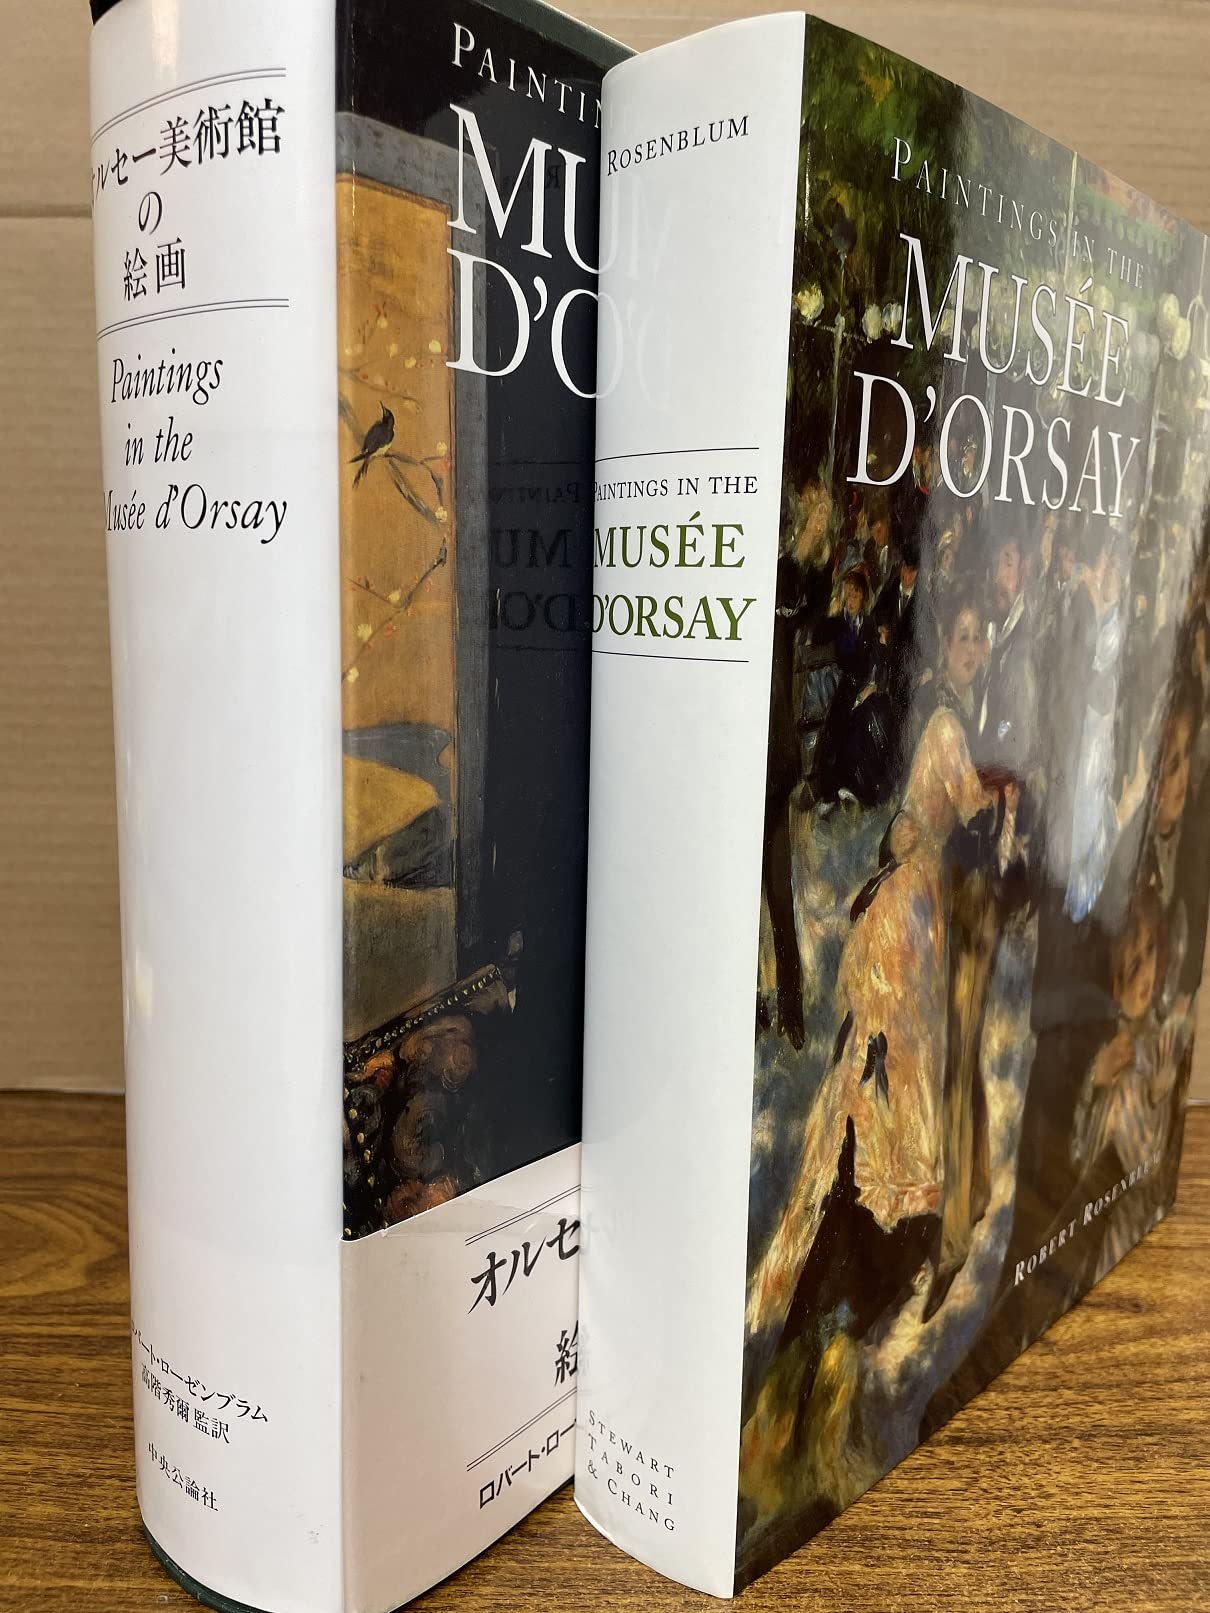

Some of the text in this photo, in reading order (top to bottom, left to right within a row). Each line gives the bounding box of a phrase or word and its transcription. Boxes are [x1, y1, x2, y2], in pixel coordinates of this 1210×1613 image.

[606, 115, 750, 176] ROSENBLUM
[138, 191, 163, 236] の
[891, 136, 1144, 289] PAINTINGS IN THE
[123, 238, 186, 302] 絵画
[891, 232, 1129, 408] MUSÉE
[111, 347, 224, 405] Paintings
[125, 416, 193, 467] in the
[846, 370, 1141, 518] D'ORSAY
[155, 483, 288, 545] d'Orsay
[677, 477, 700, 496] IN
[708, 476, 758, 495] THE
[594, 510, 746, 568] MUSÉE
[467, 1217, 581, 1315] オルセ
[1014, 1219, 1077, 1286] ROBERT
[194, 1407, 230, 1444] 監訳
[589, 1409, 675, 1479] STEWART
[148, 1442, 219, 1512] 中央公論社
[588, 1432, 674, 1506] TABORI
[588, 1459, 675, 1532] & CHANG
